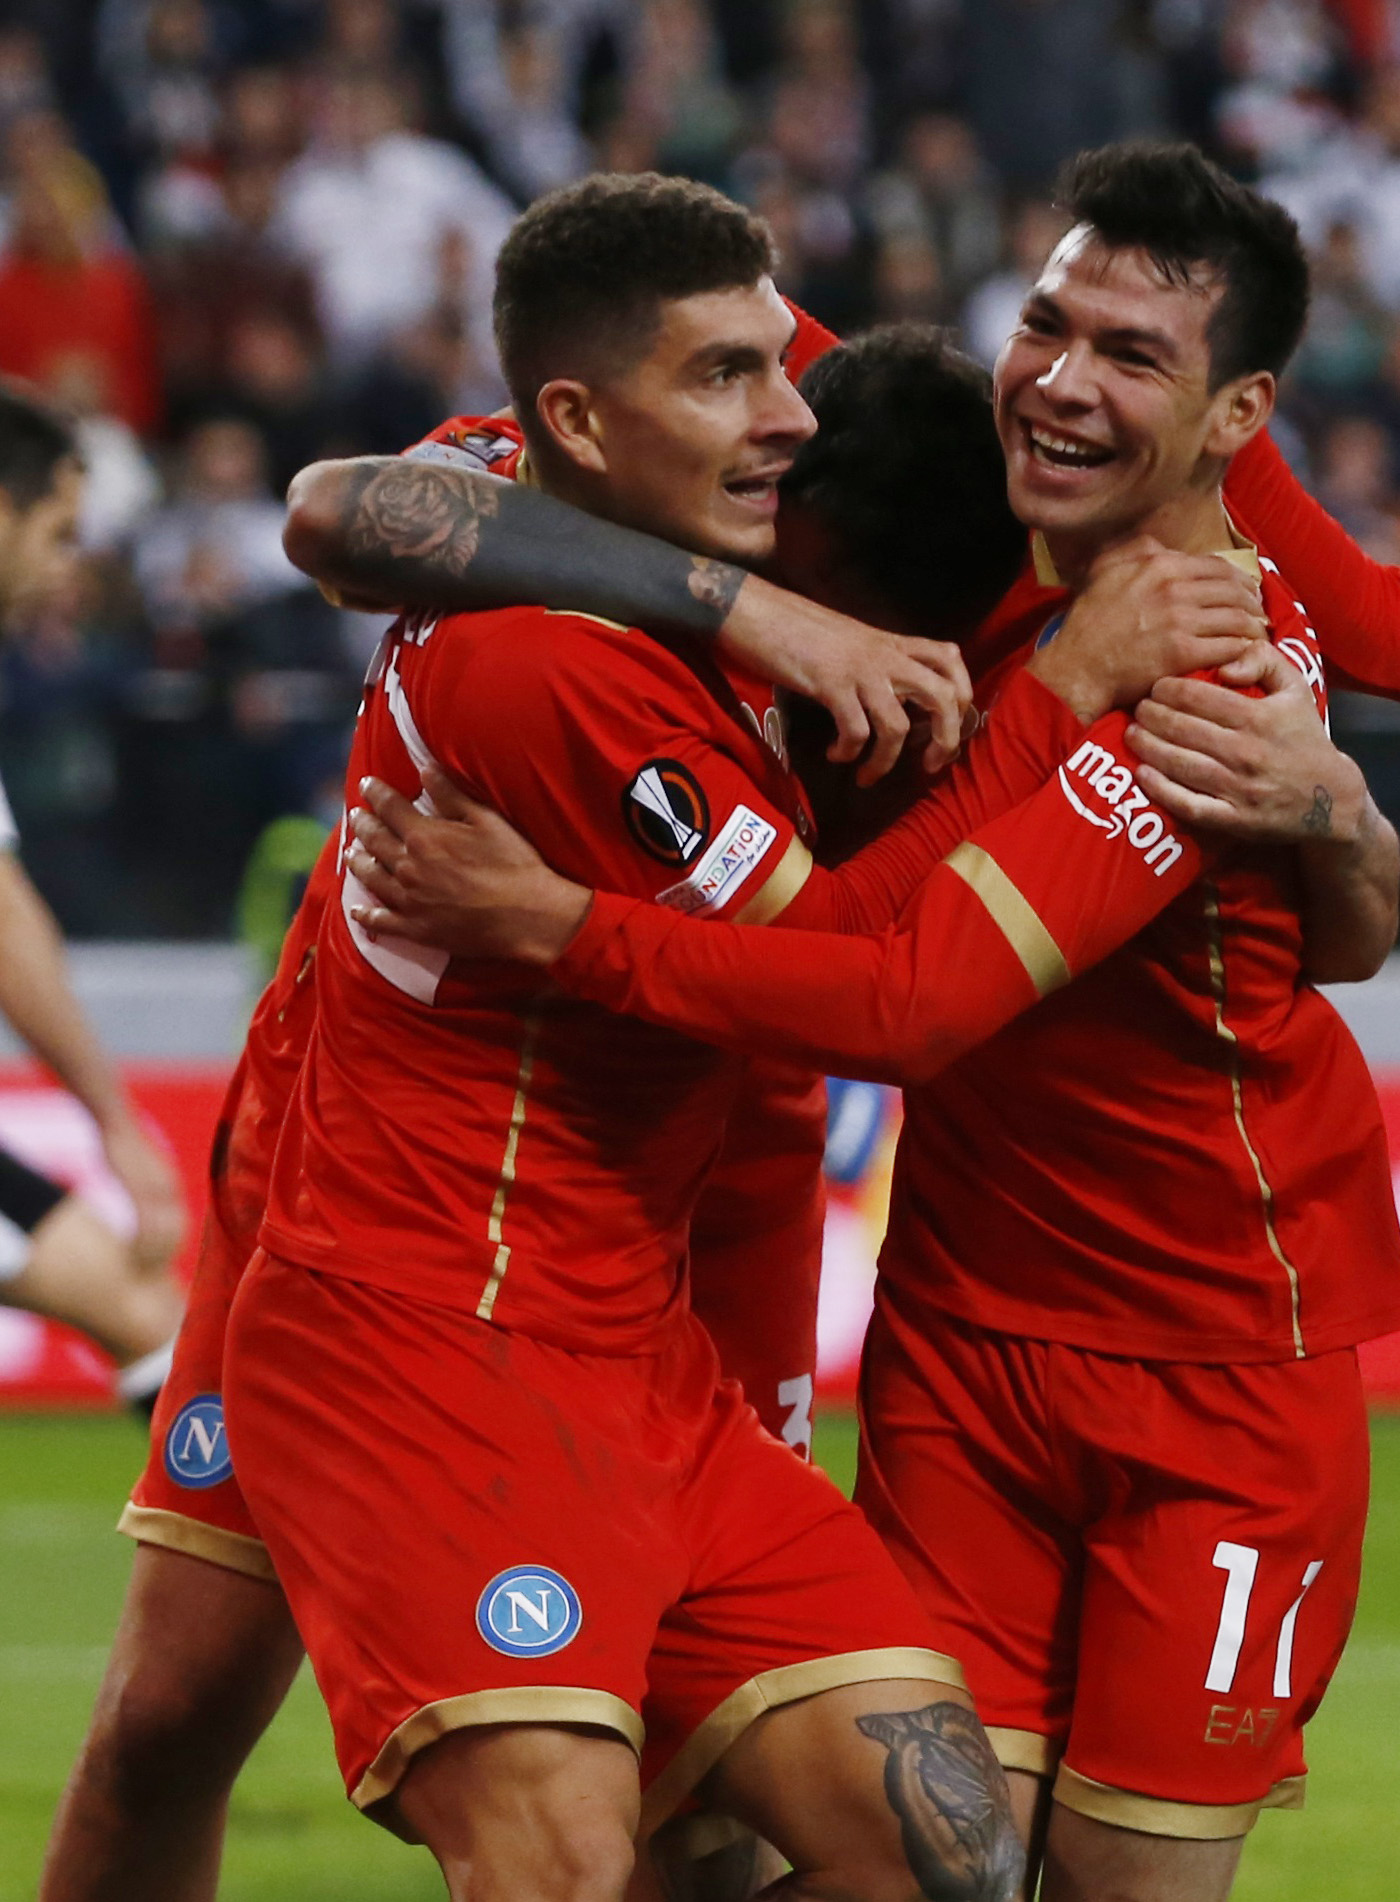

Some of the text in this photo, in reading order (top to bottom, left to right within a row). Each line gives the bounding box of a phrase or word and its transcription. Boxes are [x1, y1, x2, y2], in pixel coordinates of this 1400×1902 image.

[1066, 739, 1184, 877] mazon
[178, 1415, 225, 1465] N
[505, 1589, 552, 1633] N
[1204, 1540, 1325, 1699] 11
[1203, 1704, 1280, 1747] EA7
